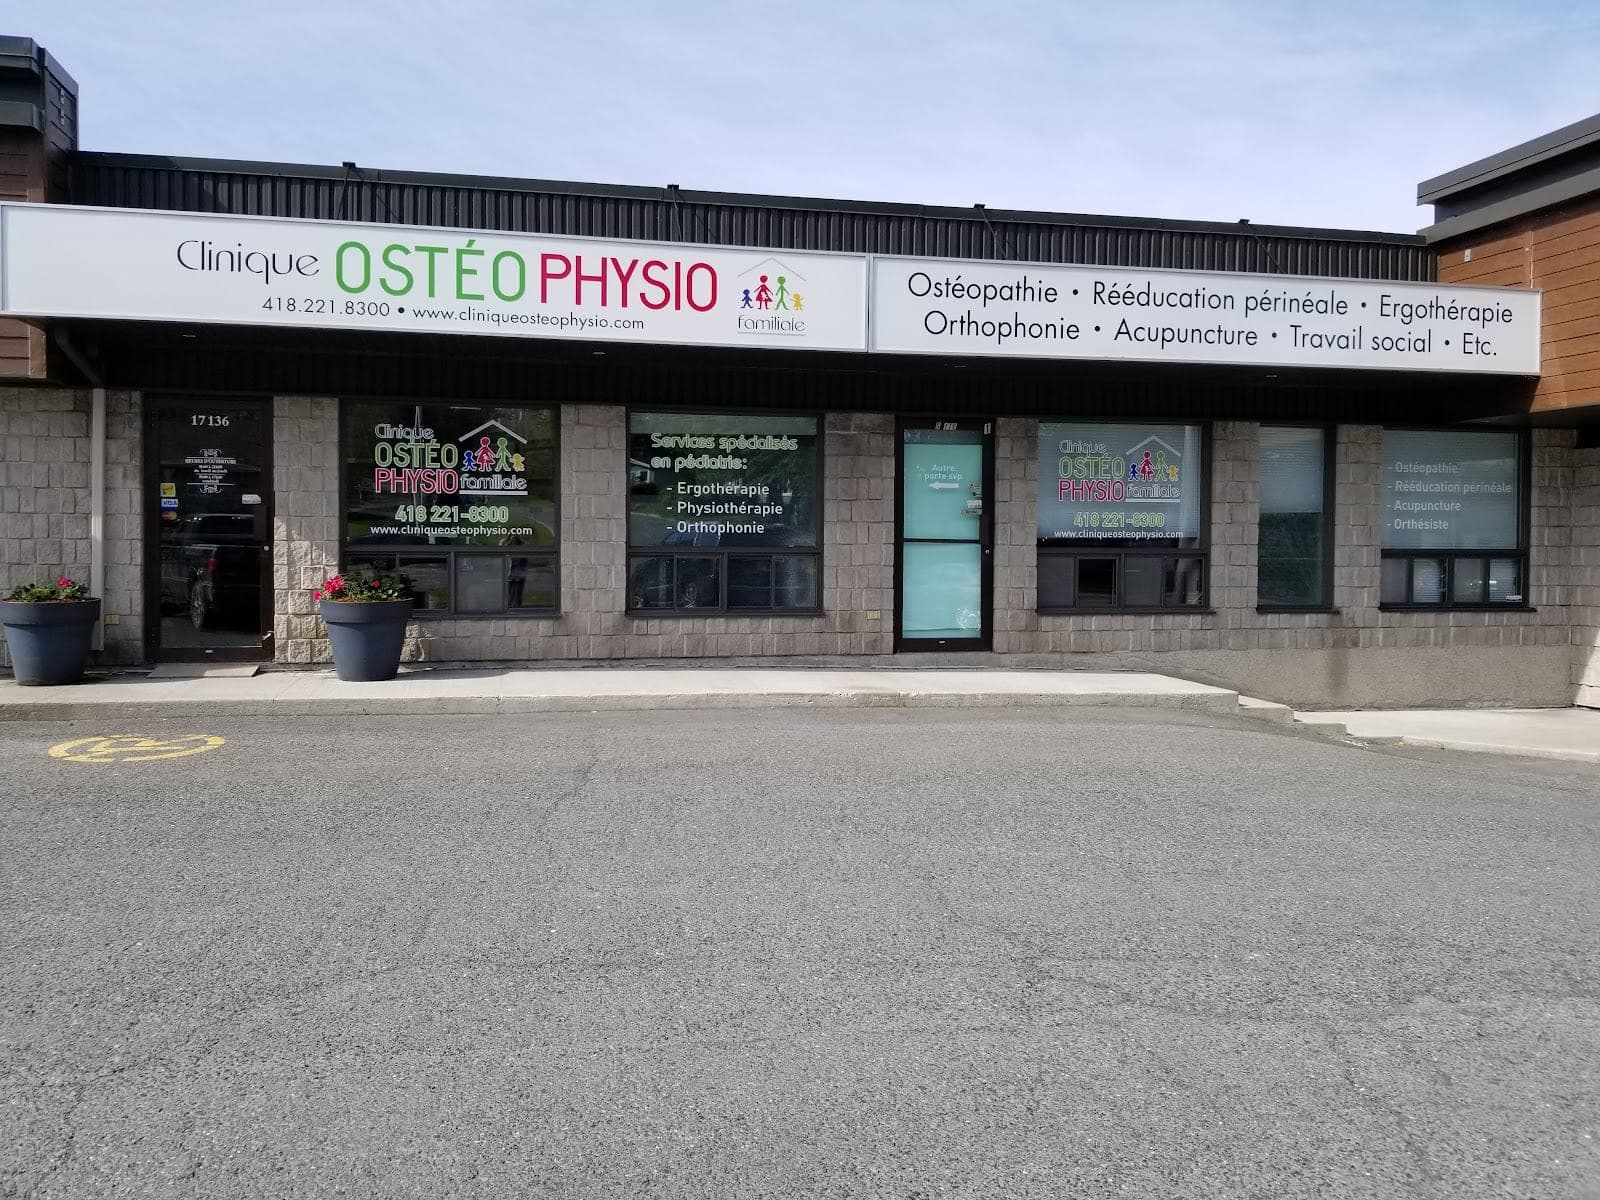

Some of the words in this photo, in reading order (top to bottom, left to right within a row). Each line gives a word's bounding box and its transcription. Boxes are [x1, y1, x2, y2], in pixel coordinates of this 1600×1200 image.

[176, 240, 320, 285] Clinique
[335, 239, 526, 302] OSTÉO
[540, 253, 718, 312] PHYSIO
[908, 272, 1058, 308] Ostéopathie
[1093, 281, 1235, 310] Rééducation
[1244, 289, 1349, 319] périnéale
[1380, 294, 1514, 328] Ergothérapie
[262, 296, 390, 318] 418.221.8300
[412, 306, 645, 331] www.cliniqueosteophysio.com
[737, 314, 806, 333] familiale
[924, 310, 1080, 345] Orthophonie
[1114, 317, 1258, 350] Acupuncture
[1289, 324, 1363, 351] Travail
[1371, 328, 1432, 353] social
[1462, 332, 1497, 356] Etc.
[374, 423, 435, 443] Clinique
[650, 432, 716, 450] Services
[718, 434, 799, 453] spécialisés
[1058, 439, 1106, 456] Clinique
[374, 439, 459, 469] OSTÉO
[650, 455, 671, 469] en
[674, 453, 748, 473] pédiatrie:
[1058, 452, 1125, 479] OSTÉO
[1395, 461, 1458, 475] Ostéopathie
[374, 467, 459, 495] PHYSIO
[459, 473, 528, 490] familiale
[924, 472, 947, 480] porte
[677, 481, 770, 498] Ergothérapie
[1058, 479, 1125, 502] PHYSIO
[1126, 483, 1182, 499] familiale
[1395, 480, 1460, 493] Rééducation
[394, 504, 427, 523] 418
[430, 505, 509, 523] 221-8300
[677, 501, 783, 518] Physiothérapie
[1394, 500, 1462, 513] Acupuncture
[677, 520, 765, 536] Orthophonie
[1074, 511, 1100, 528] 418
[1102, 512, 1165, 528] 221-8300
[1394, 518, 1449, 530] Orthésiste
[370, 525, 533, 537] www.cliniqueosteophysio.com
[1054, 529, 1184, 541] www.cliniqueosteophysio.com
